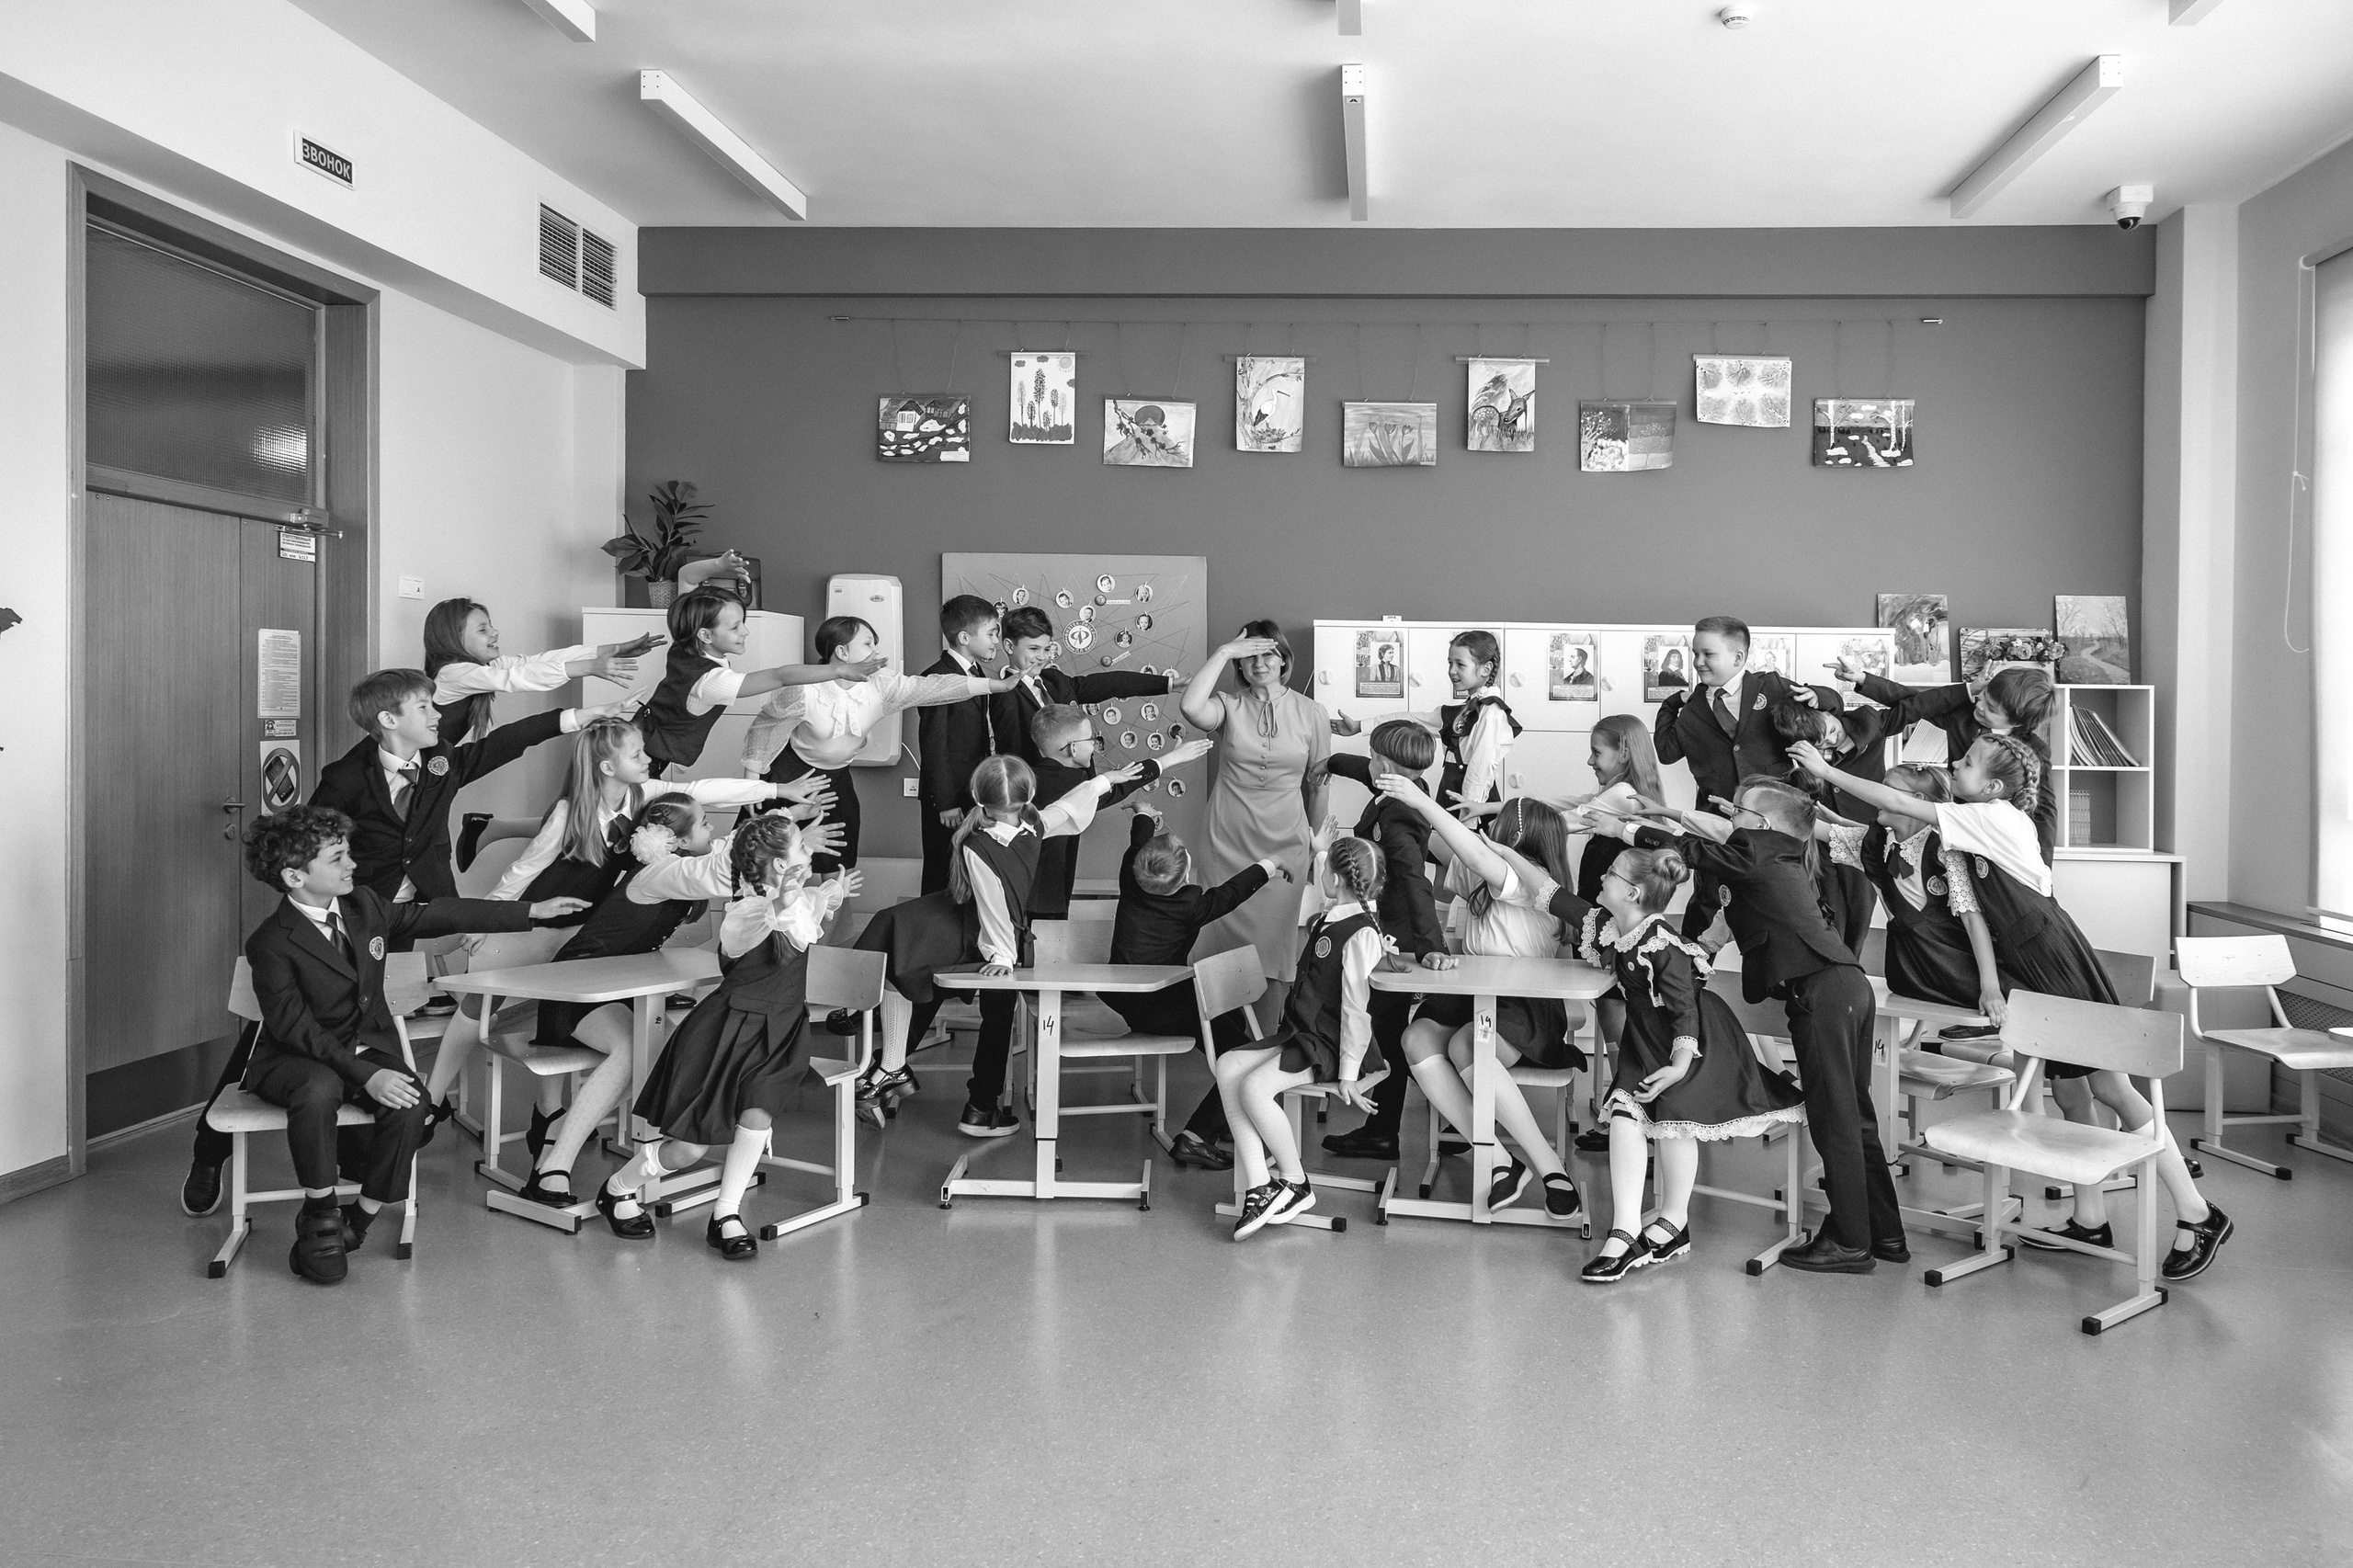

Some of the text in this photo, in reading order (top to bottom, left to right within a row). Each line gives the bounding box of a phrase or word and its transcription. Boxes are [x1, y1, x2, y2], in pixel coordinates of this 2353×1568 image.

[302, 142, 350, 179] ЗВОНОК
[1042, 1016, 1054, 1036] 14
[1874, 1039, 1884, 1056] 14
